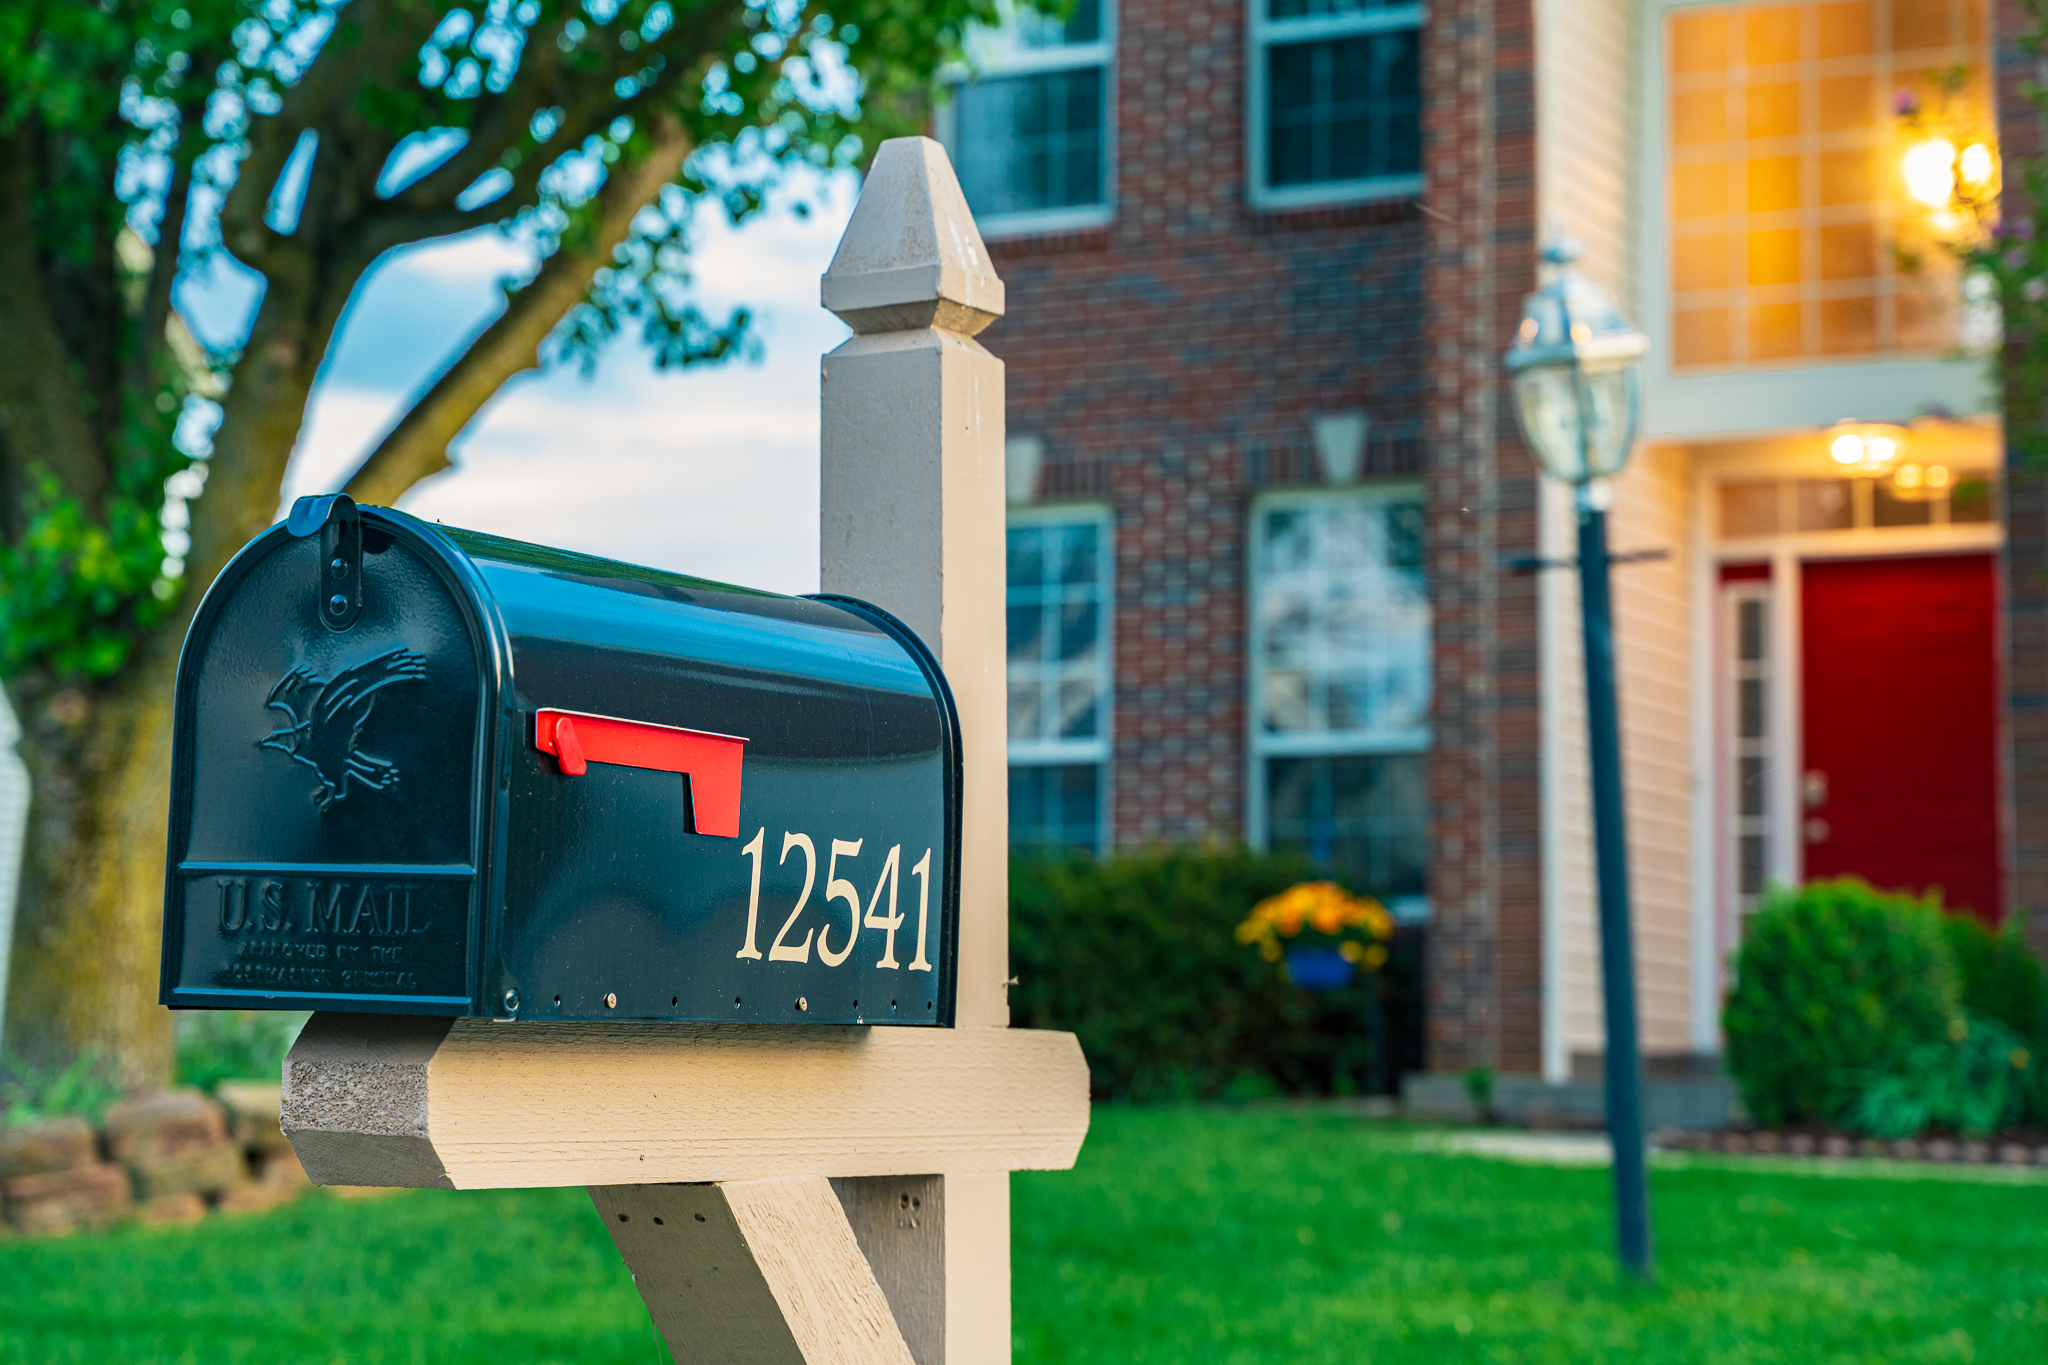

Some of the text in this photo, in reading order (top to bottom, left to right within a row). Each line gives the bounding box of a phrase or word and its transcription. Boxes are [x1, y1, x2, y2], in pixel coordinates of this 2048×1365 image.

[217, 879, 433, 937] U.S. MAIL
[736, 826, 933, 972] 12541
